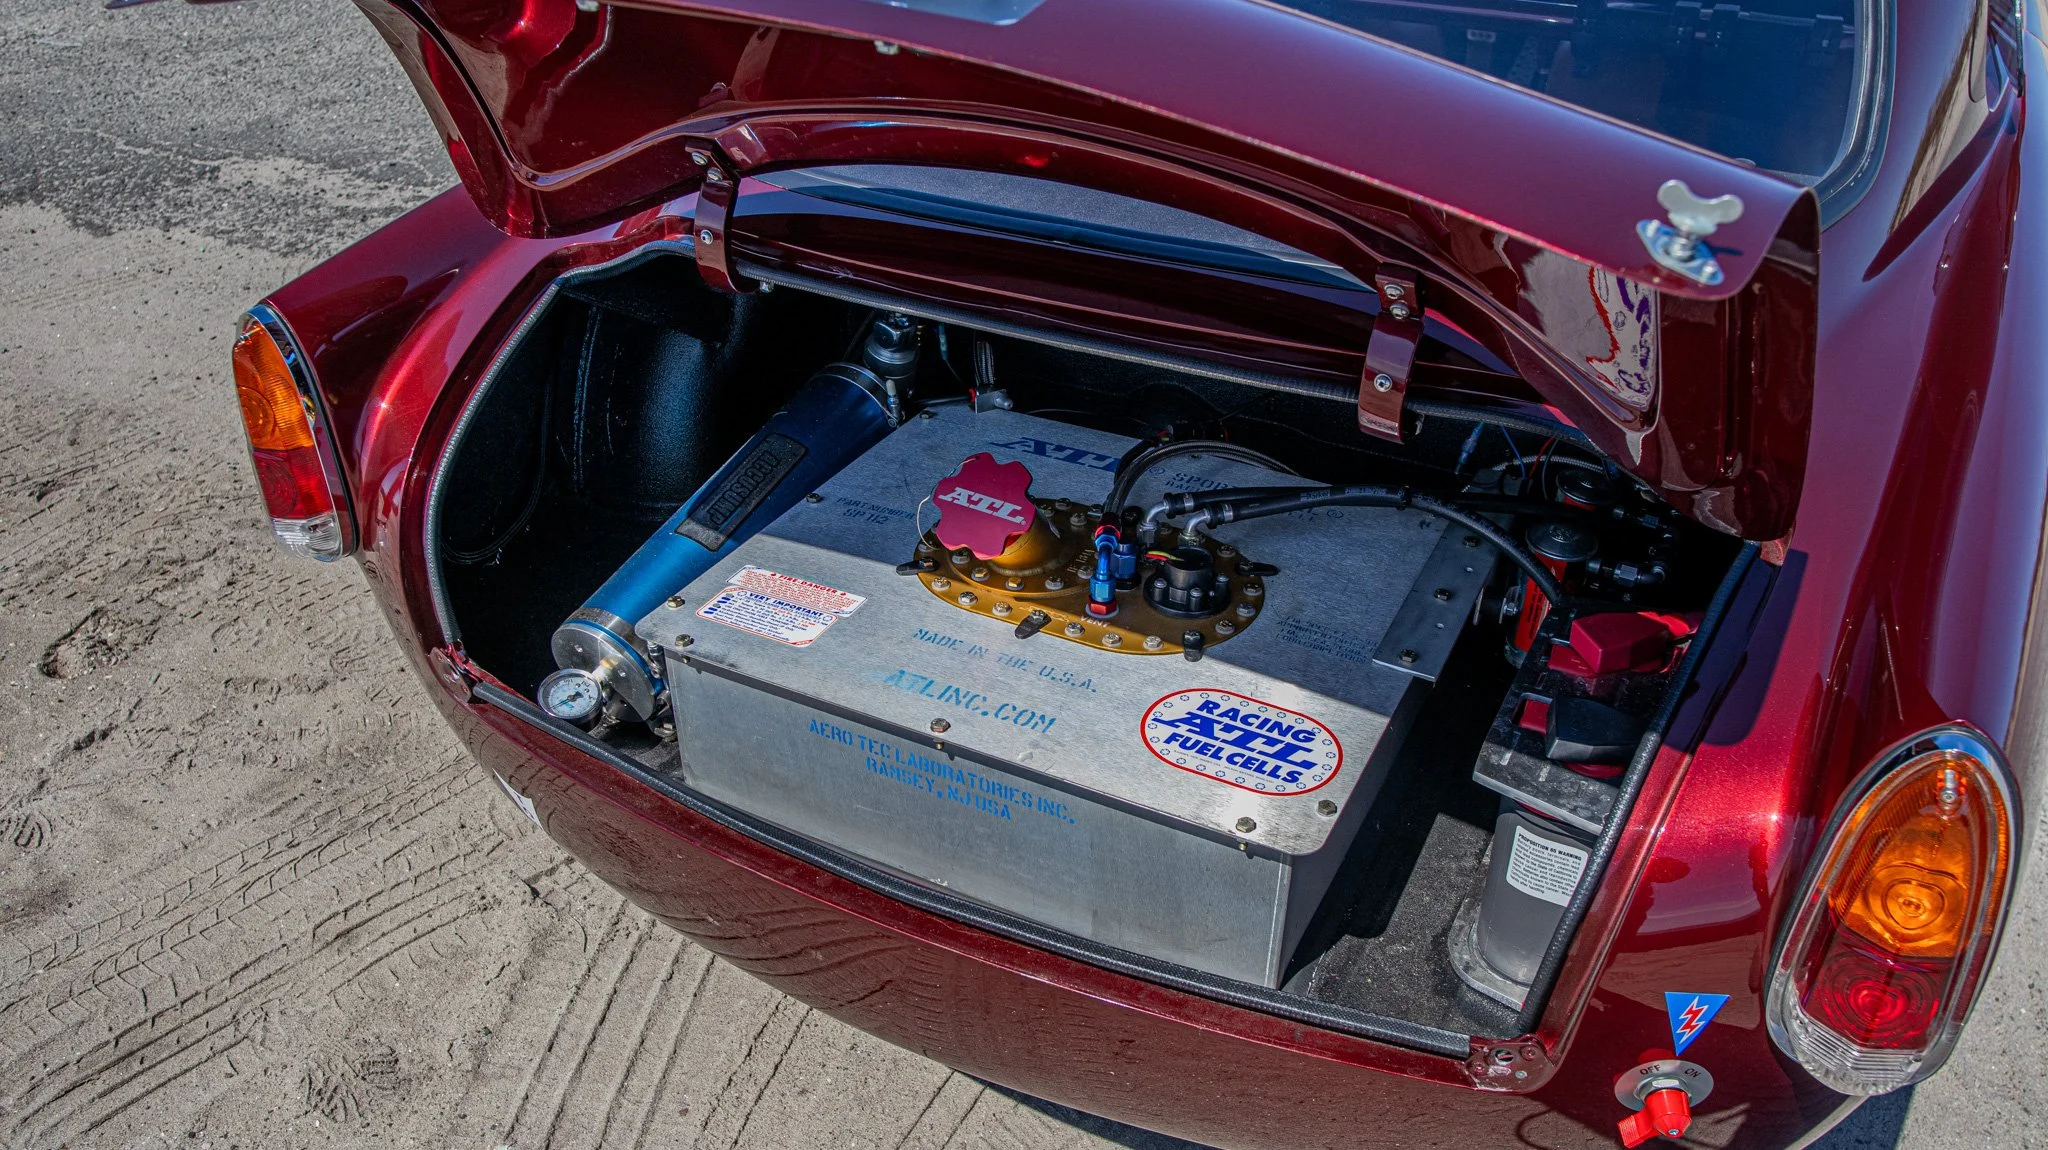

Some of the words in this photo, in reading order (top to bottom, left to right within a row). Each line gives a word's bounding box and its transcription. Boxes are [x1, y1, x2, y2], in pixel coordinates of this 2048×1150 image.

[707, 449, 780, 526] ACCUSUMP
[836, 496, 869, 508] PART
[868, 504, 916, 520] NUMBER
[938, 486, 1025, 524] ATL
[801, 581, 838, 594] DANGER
[749, 592, 770, 602] VERY
[772, 600, 824, 617] IMPORTANT
[1080, 615, 1111, 628] VENT
[912, 628, 965, 651] MADE
[967, 644, 990, 657] IN
[995, 652, 1035, 671] THE
[1039, 665, 1097, 693] U.S.A.
[884, 669, 1058, 734] ATLINC.COM
[1196, 699, 1317, 743] RACING
[1151, 710, 1319, 771] ATL
[809, 719, 854, 747] AERO
[857, 734, 892, 759] TEC
[894, 748, 1034, 809] LABORATORIES
[1036, 796, 1077, 825] INC.
[1163, 732, 1224, 762] FUEL
[1225, 752, 1304, 784] CELLS
[975, 793, 1012, 821] USA
[1518, 832, 1549, 851] PROPOSITION
[1558, 850, 1582, 861] WARNING
[1639, 1064, 1662, 1076] OFF
[1684, 1067, 1702, 1079] ON
